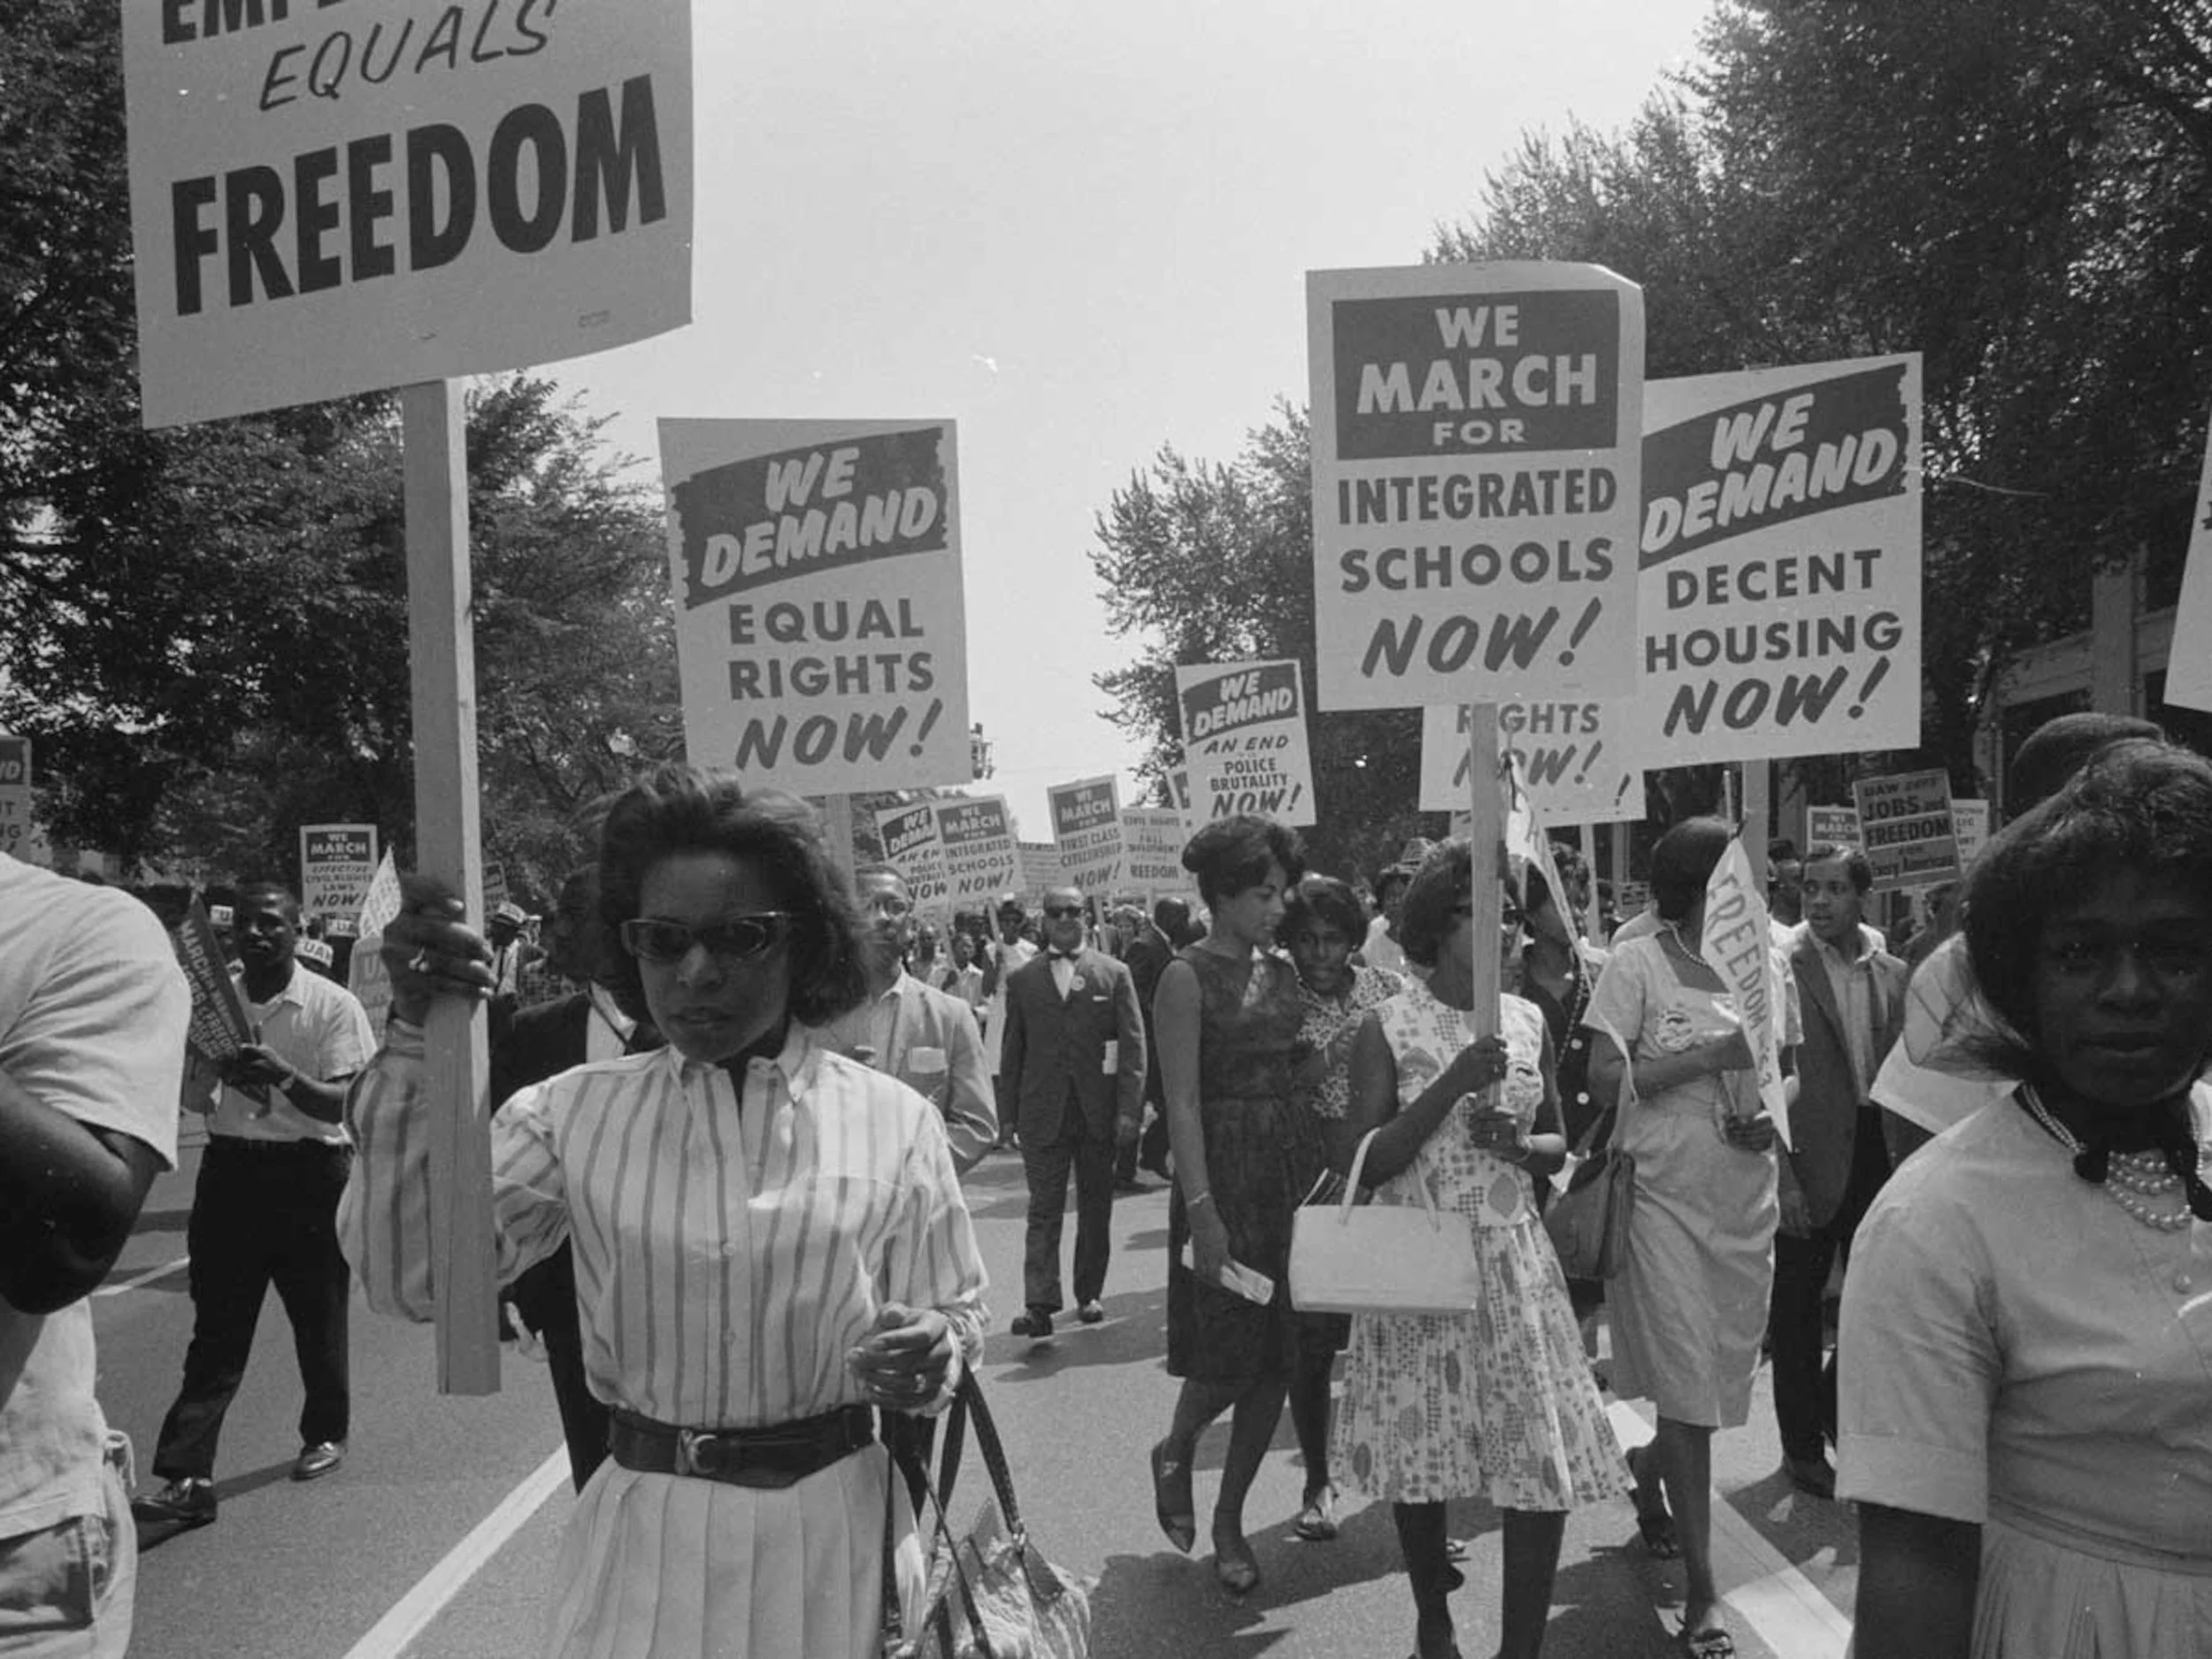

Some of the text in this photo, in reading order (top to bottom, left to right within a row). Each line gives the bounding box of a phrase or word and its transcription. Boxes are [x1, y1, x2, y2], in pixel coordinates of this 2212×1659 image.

[260, 0, 555, 111] EQUALS
[172, 73, 666, 317] FREEDOM
[1435, 304, 1519, 349] WE
[1356, 353, 1597, 414] MARCH
[1433, 419, 1528, 446] FOR
[1710, 393, 1815, 471] WE
[764, 446, 861, 513] WE
[1339, 467, 1617, 525] INTEGRATED
[1641, 427, 1899, 554] DEMAND
[700, 486, 938, 588] DEMAND
[1340, 538, 1613, 593] SCHOOLS
[1667, 549, 1882, 610] DECENT
[729, 598, 925, 645] EQUAL
[1361, 595, 1602, 679] NOW!
[1646, 611, 1903, 673] HOUSING
[727, 650, 934, 701] RIGHTS
[1219, 671, 1262, 703] WE
[1663, 655, 1891, 738] NOW!
[735, 697, 943, 771] NOW!
[1194, 687, 1294, 737] DEMAND
[1456, 703, 1601, 734] RGHTS
[1203, 734, 1290, 755] AN END
[1224, 757, 1277, 775] POLICE
[1210, 773, 1287, 792] BRUTALITY
[1211, 783, 1302, 818] NOW!
[1864, 795, 1918, 820] JOBS
[310, 842, 367, 856] MARCH
[945, 814, 1001, 835] MARCH
[945, 839, 1011, 859] INTEGRATED
[1867, 818, 1950, 846] FREEDOM
[921, 849, 941, 861] EN
[947, 854, 1015, 876] SCHOOLS
[180, 919, 212, 979] MARCH
[1706, 872, 1768, 1032] FREEDOM
